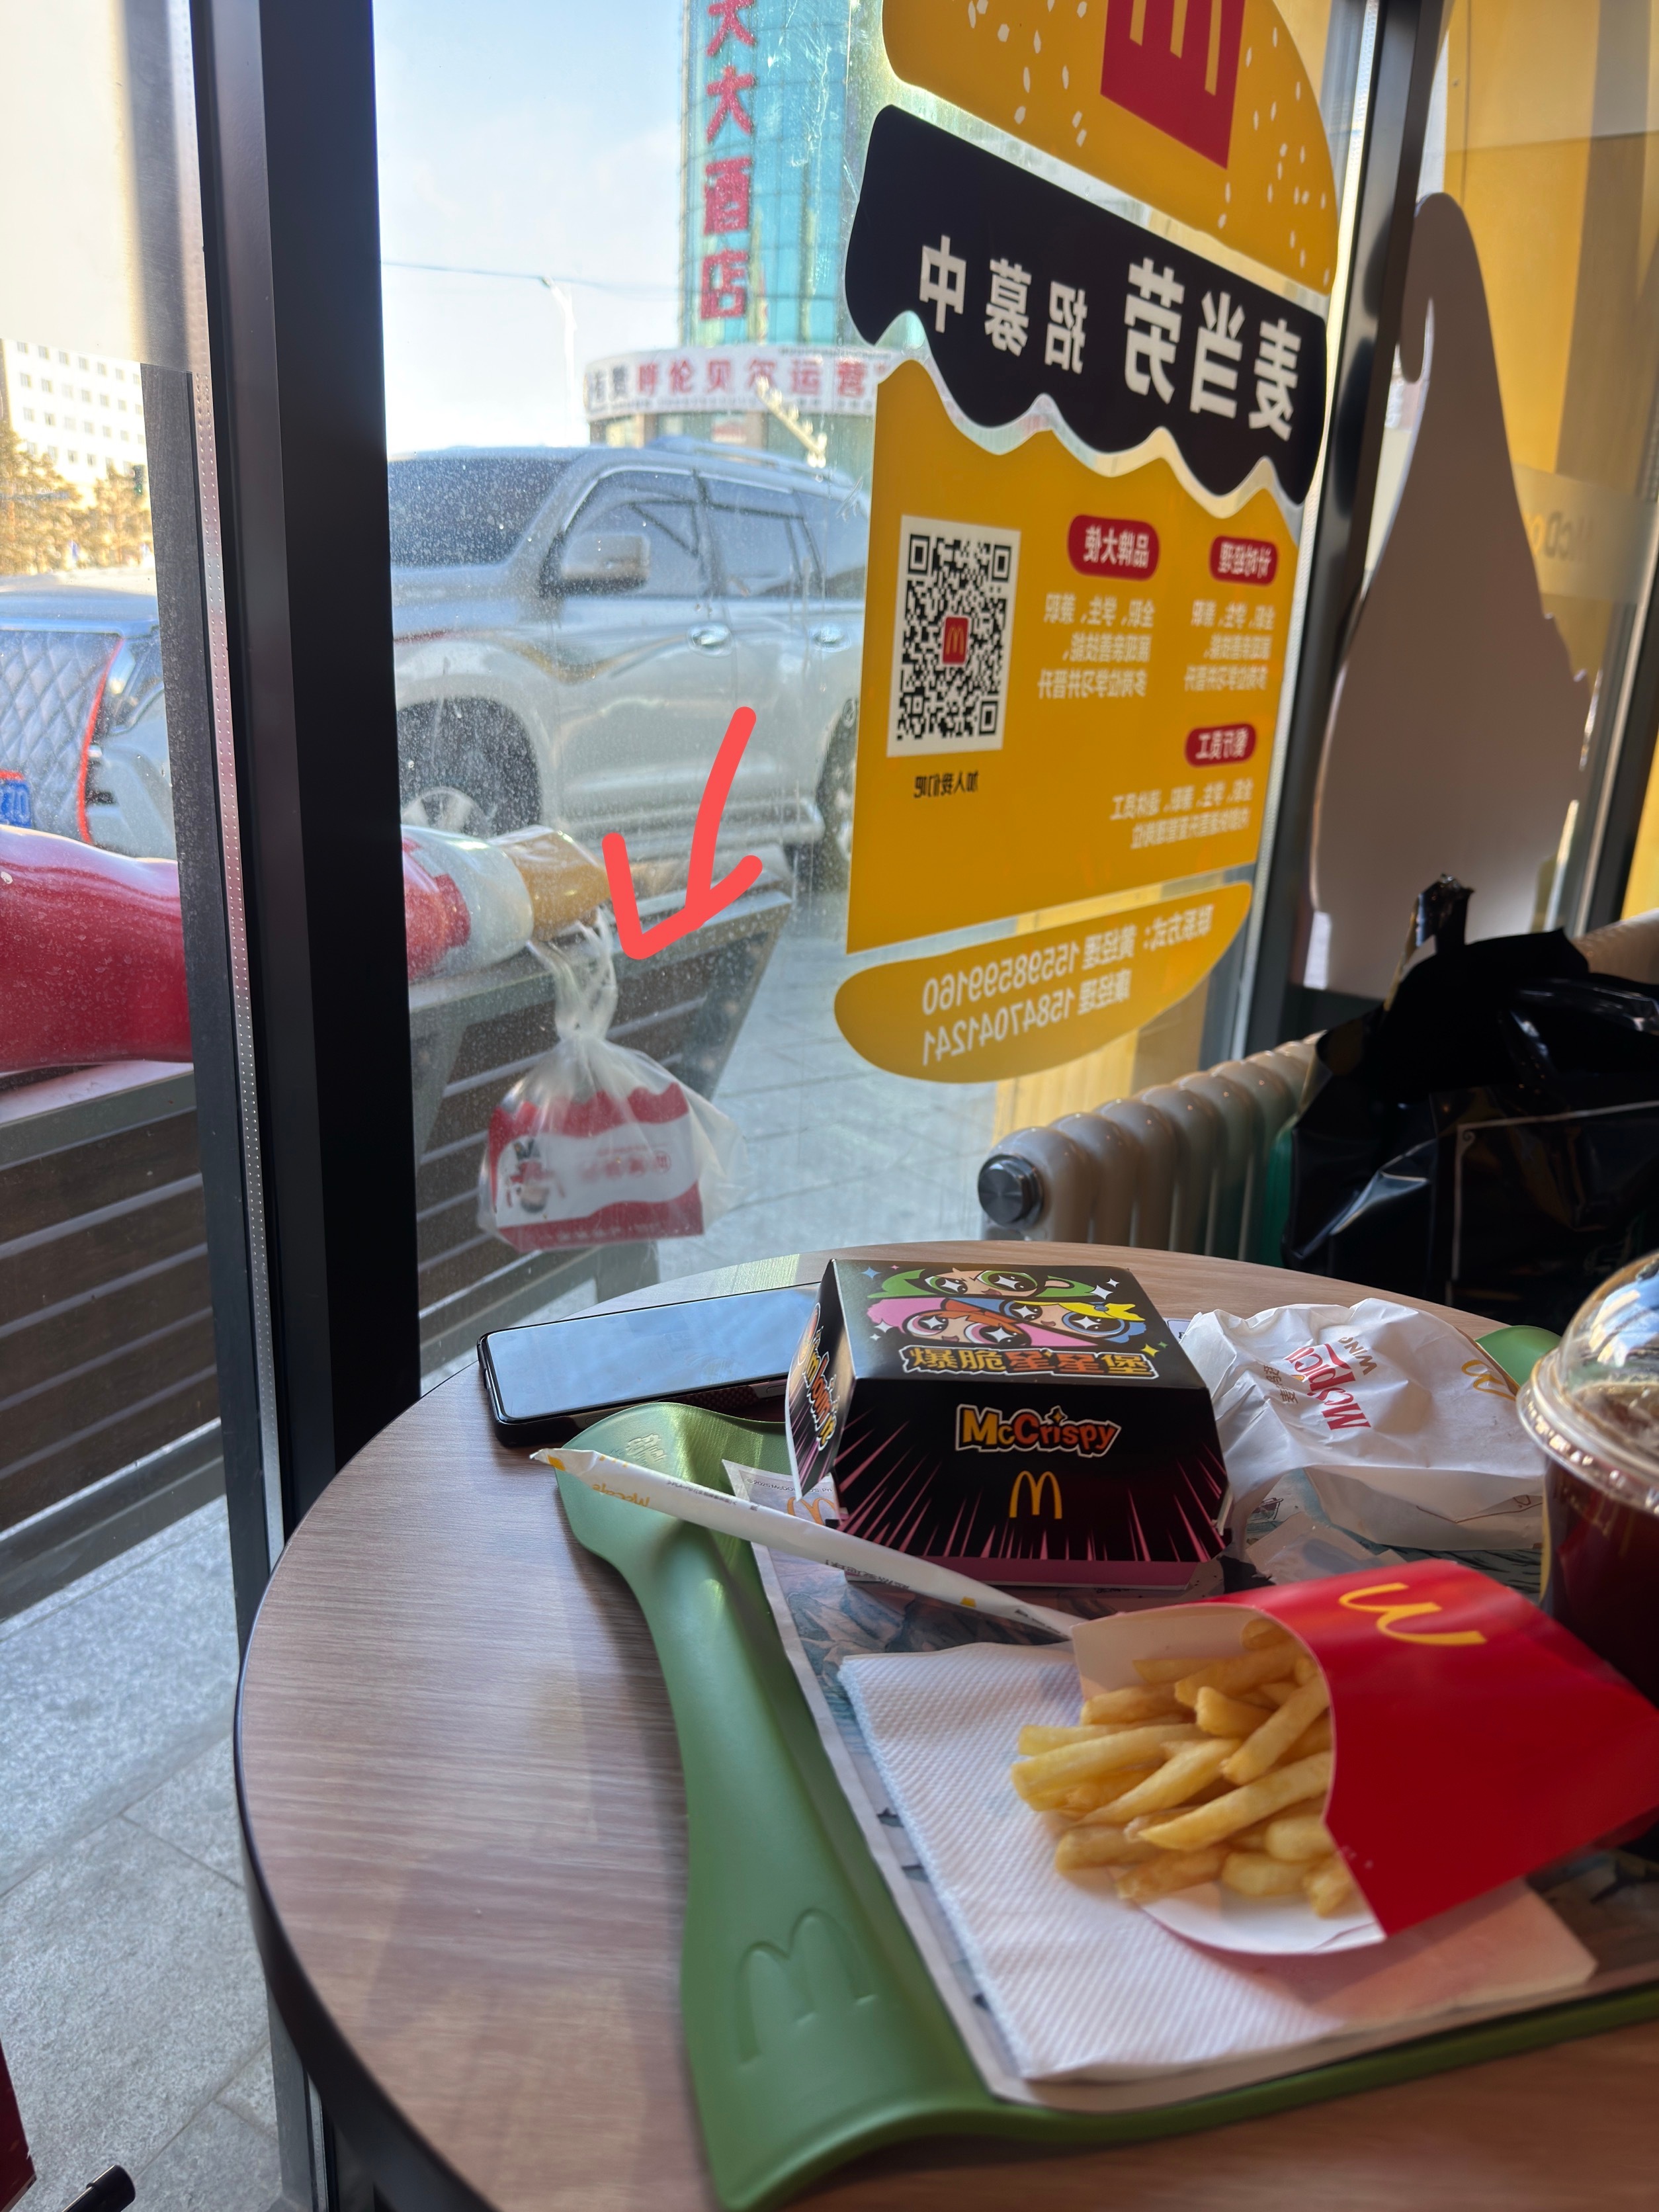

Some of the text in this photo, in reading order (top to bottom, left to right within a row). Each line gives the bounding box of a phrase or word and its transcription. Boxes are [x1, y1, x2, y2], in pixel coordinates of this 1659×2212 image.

[906, 1347, 1154, 1377] 爆脆星星堡
[960, 1406, 1119, 1454] McCrispy
